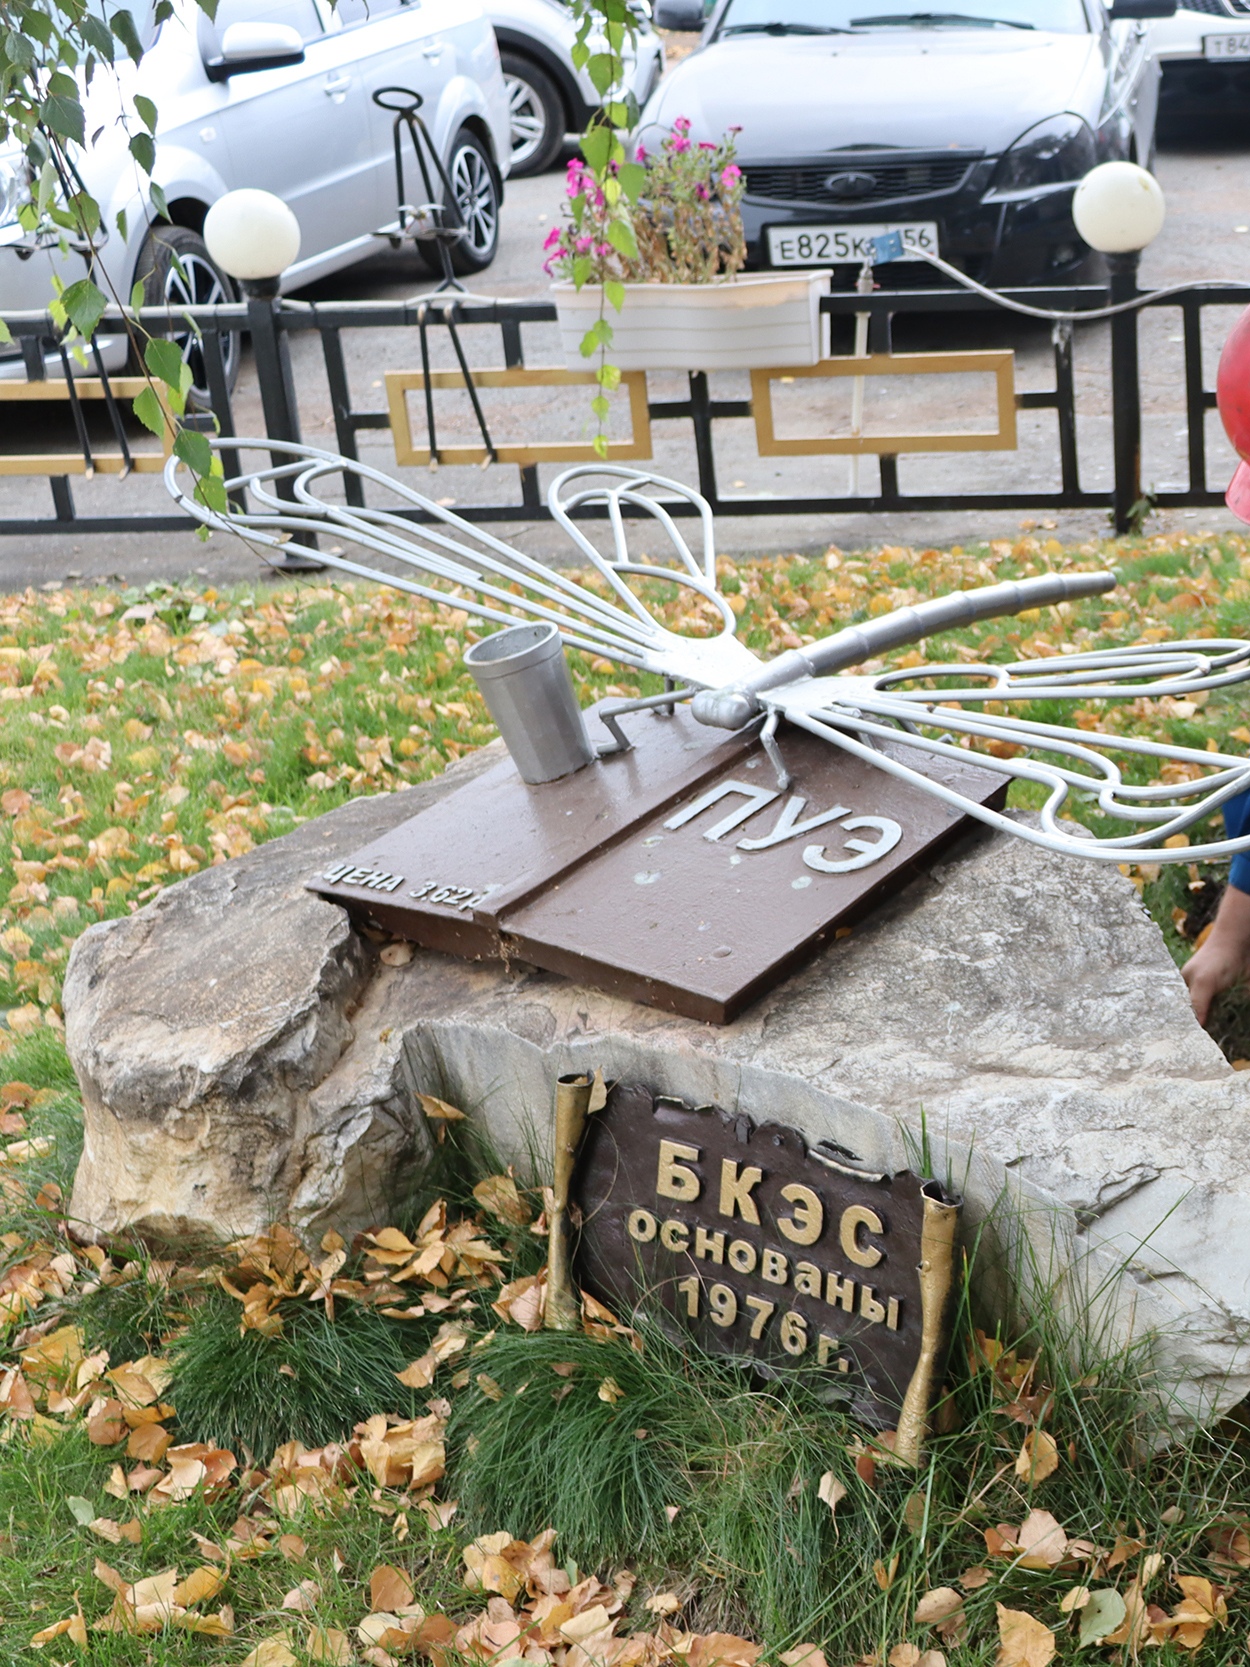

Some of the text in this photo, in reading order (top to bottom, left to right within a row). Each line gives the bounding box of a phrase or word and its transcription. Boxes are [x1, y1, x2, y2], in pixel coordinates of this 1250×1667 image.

[780, 228, 932, 260] Е825К 56
[663, 779, 902, 874] ПУЭ
[323, 864, 405, 892] ЦЕНА
[656, 1138, 884, 1268] БКЭС
[627, 1209, 900, 1331] основаны
